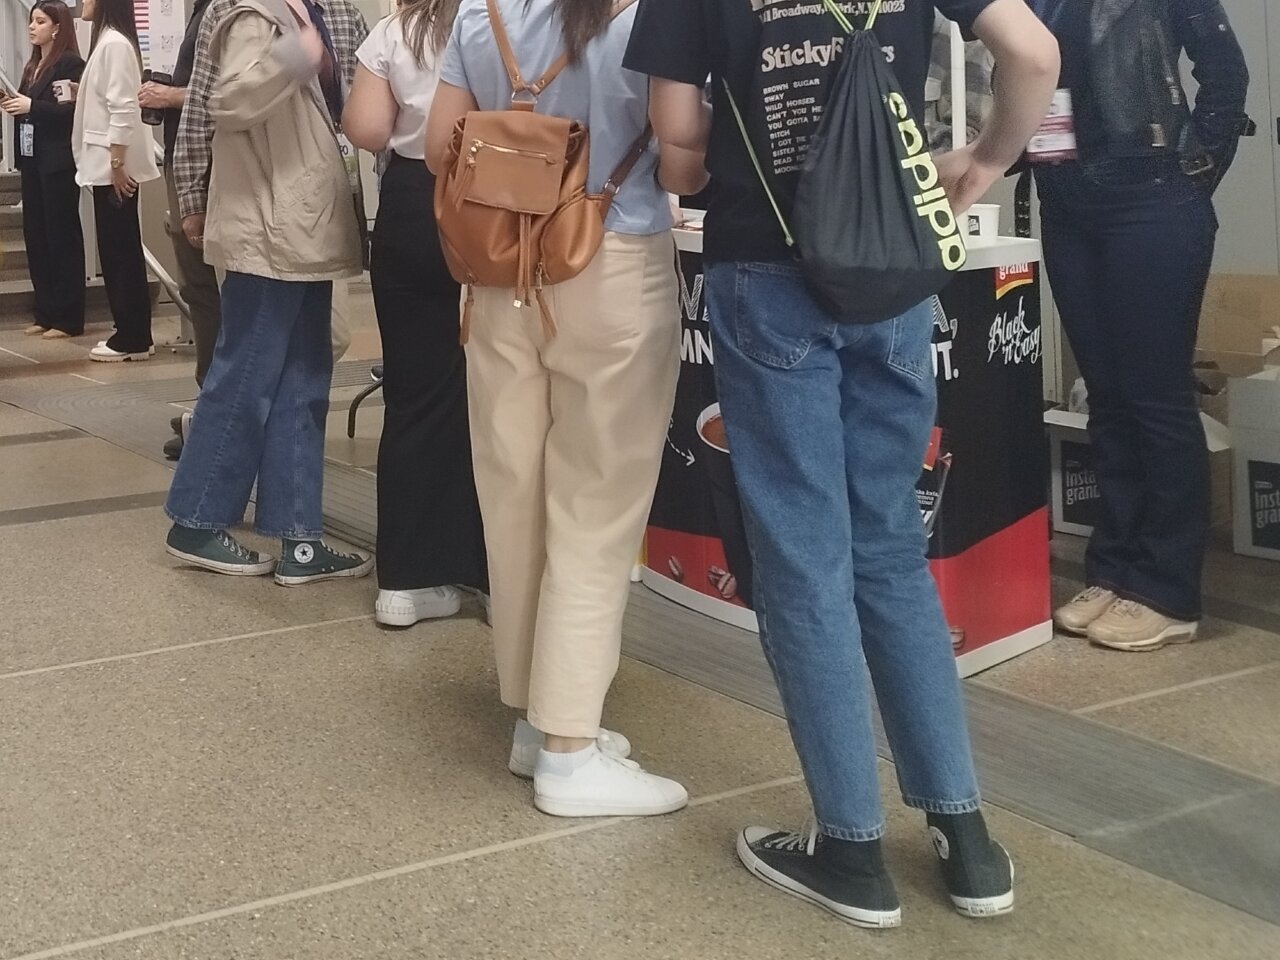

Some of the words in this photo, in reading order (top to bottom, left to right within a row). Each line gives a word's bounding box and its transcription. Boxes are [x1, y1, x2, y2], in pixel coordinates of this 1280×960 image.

[761, 40, 832, 72] Sticky
[763, 83, 789, 95] BROWN
[793, 78, 820, 88] SUGAR
[764, 93, 785, 103] SWAY
[765, 103, 783, 113] WILD
[786, 97, 815, 108] HORSES
[766, 111, 787, 121] CAN'T
[792, 108, 807, 116] YOU
[768, 122, 783, 130] YOU
[786, 117, 808, 126] GOTTA
[769, 129, 790, 140] BITCH
[778, 139, 792, 147] GOT
[772, 147, 795, 157] SISTER
[987, 296, 1031, 363] Black
[1256, 489, 1280, 510] Inst
[1256, 508, 1280, 529] gra
